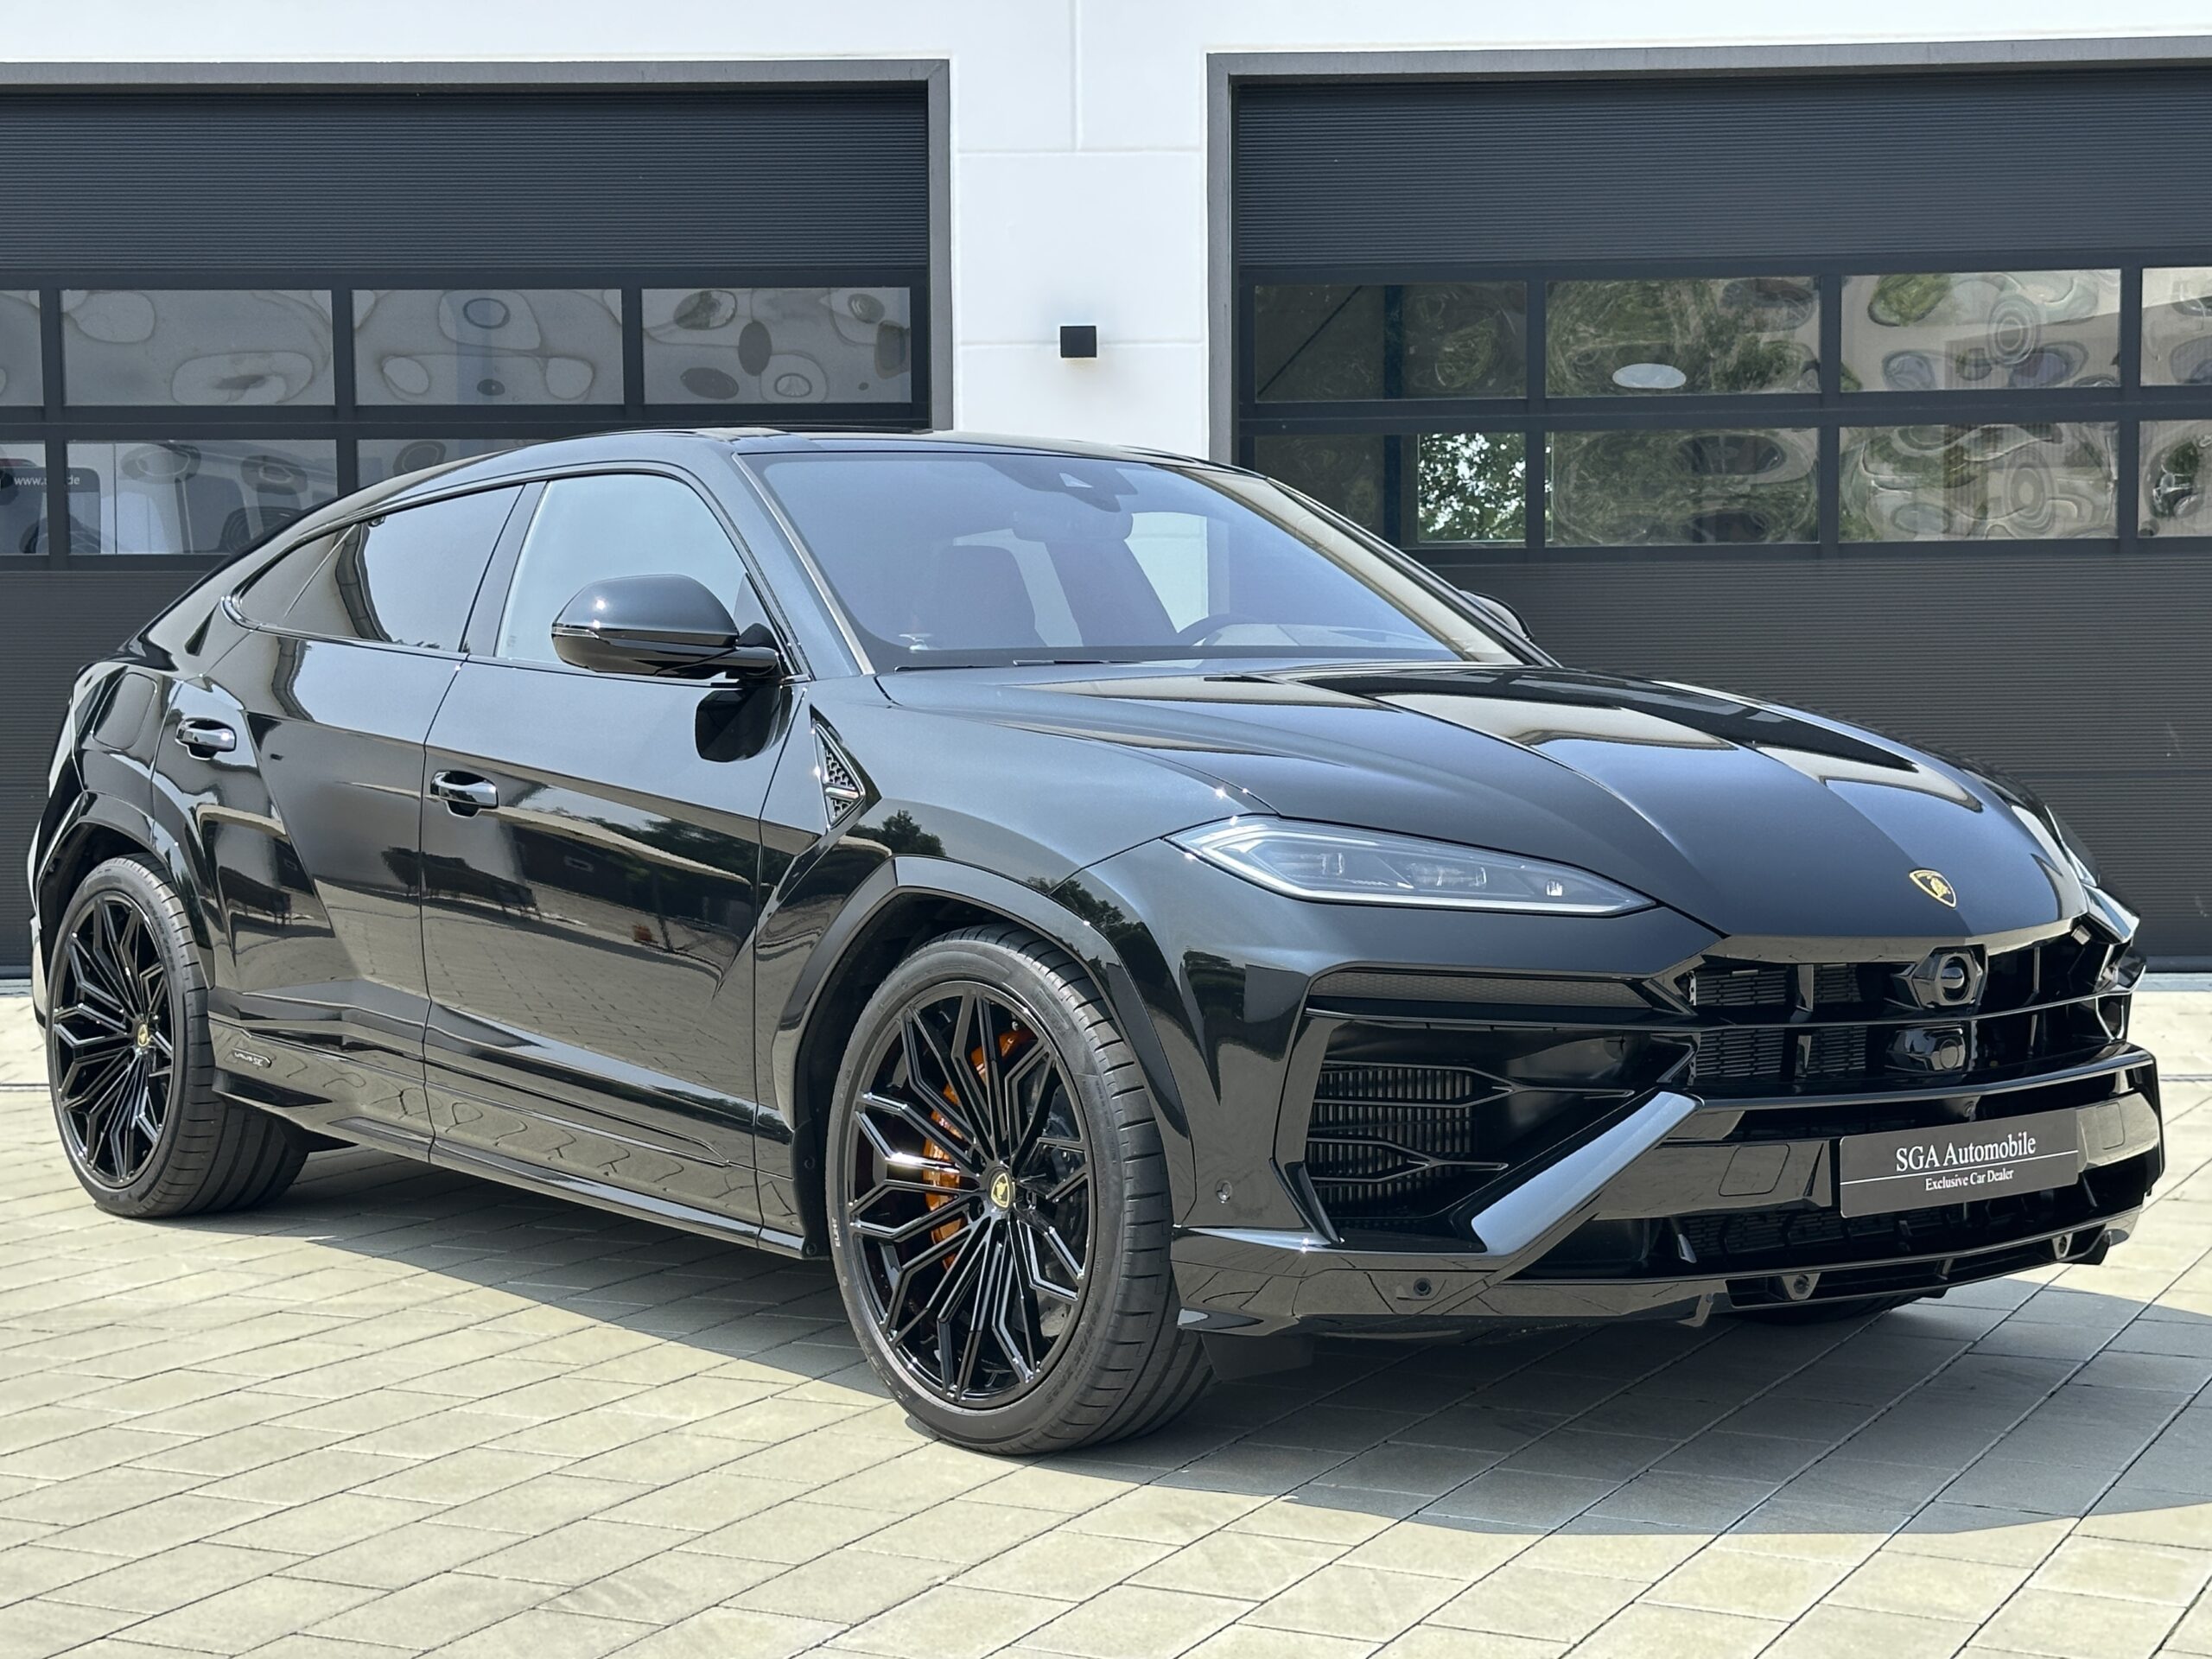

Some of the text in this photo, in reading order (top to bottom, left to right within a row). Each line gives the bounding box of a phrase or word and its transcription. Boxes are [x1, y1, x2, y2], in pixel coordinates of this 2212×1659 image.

[1896, 1131, 2037, 1172] SGA Automobile
[1925, 1168, 2014, 1192] Exclusive Car Dealer
